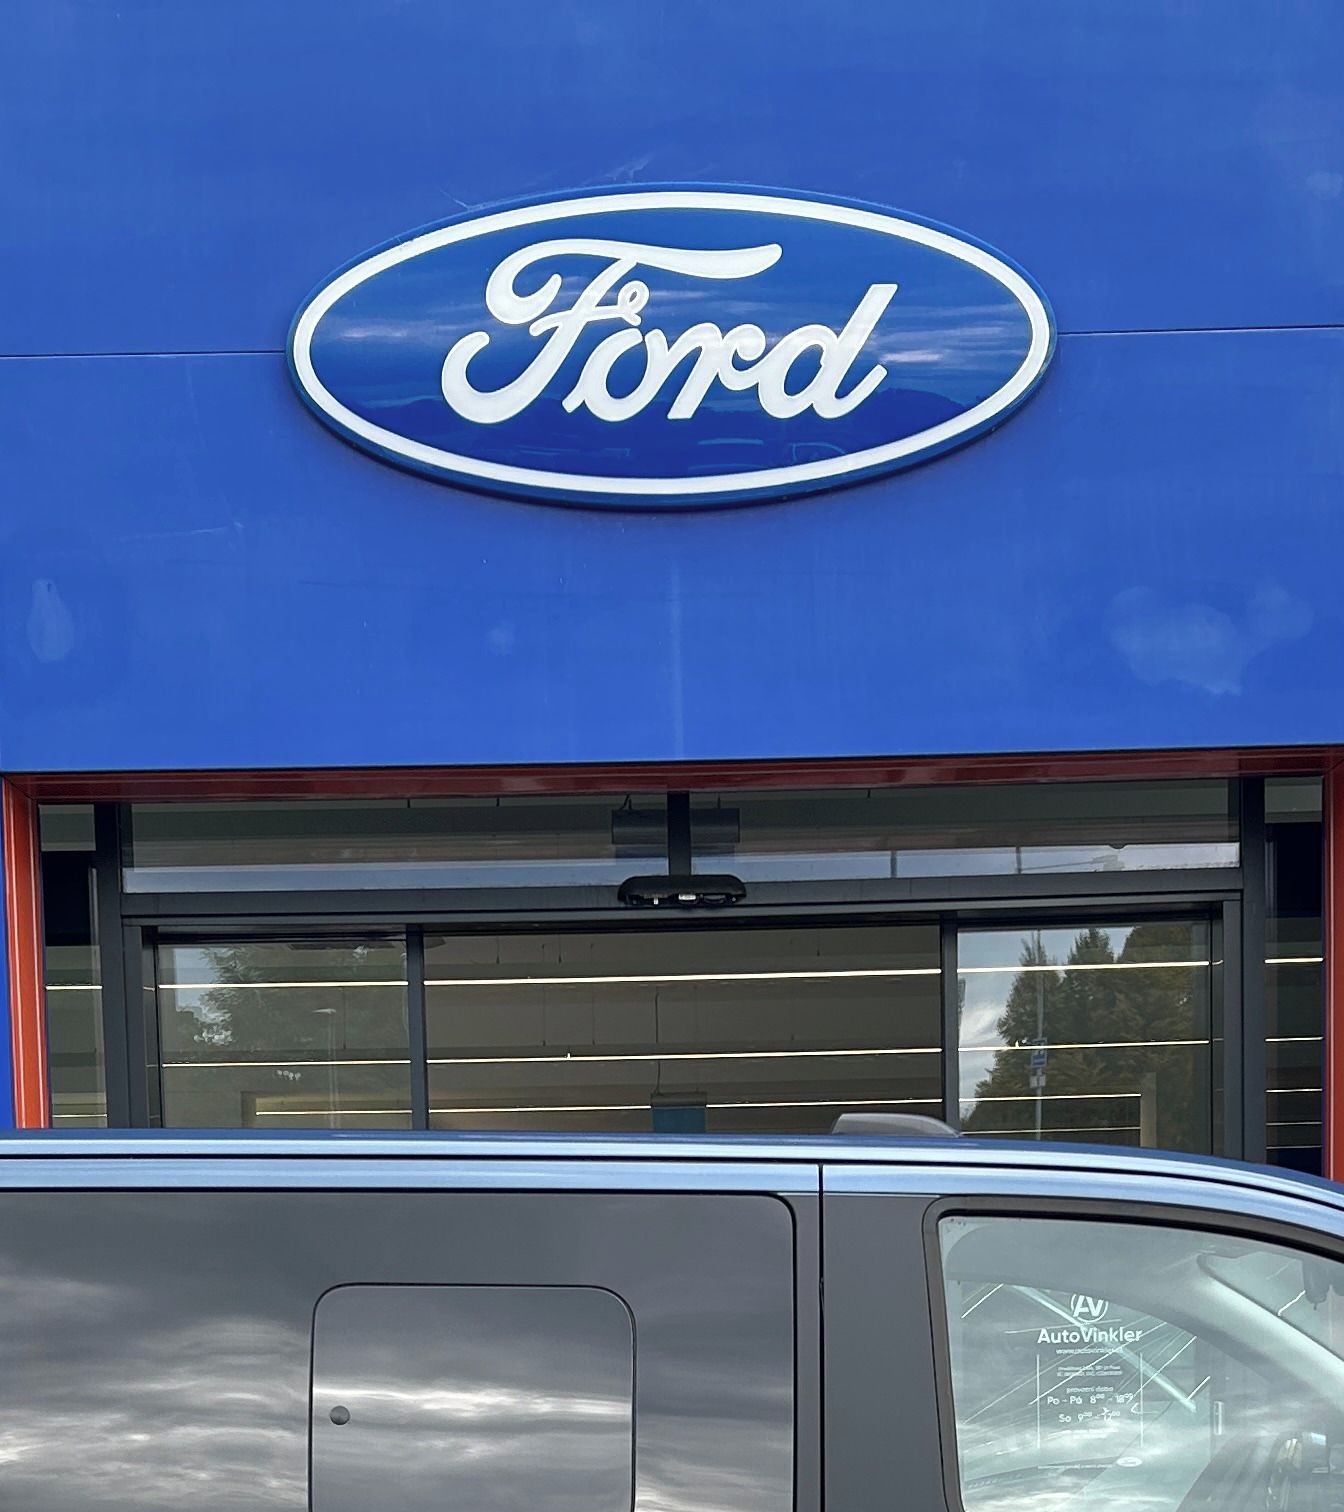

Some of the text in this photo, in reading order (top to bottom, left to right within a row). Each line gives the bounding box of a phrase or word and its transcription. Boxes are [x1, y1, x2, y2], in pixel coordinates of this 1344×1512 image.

[442, 238, 899, 424] Ford
[1037, 1327, 1143, 1344] AutoVinkler
[1047, 1397, 1060, 1405] Po
[1058, 1414, 1072, 1423] So
